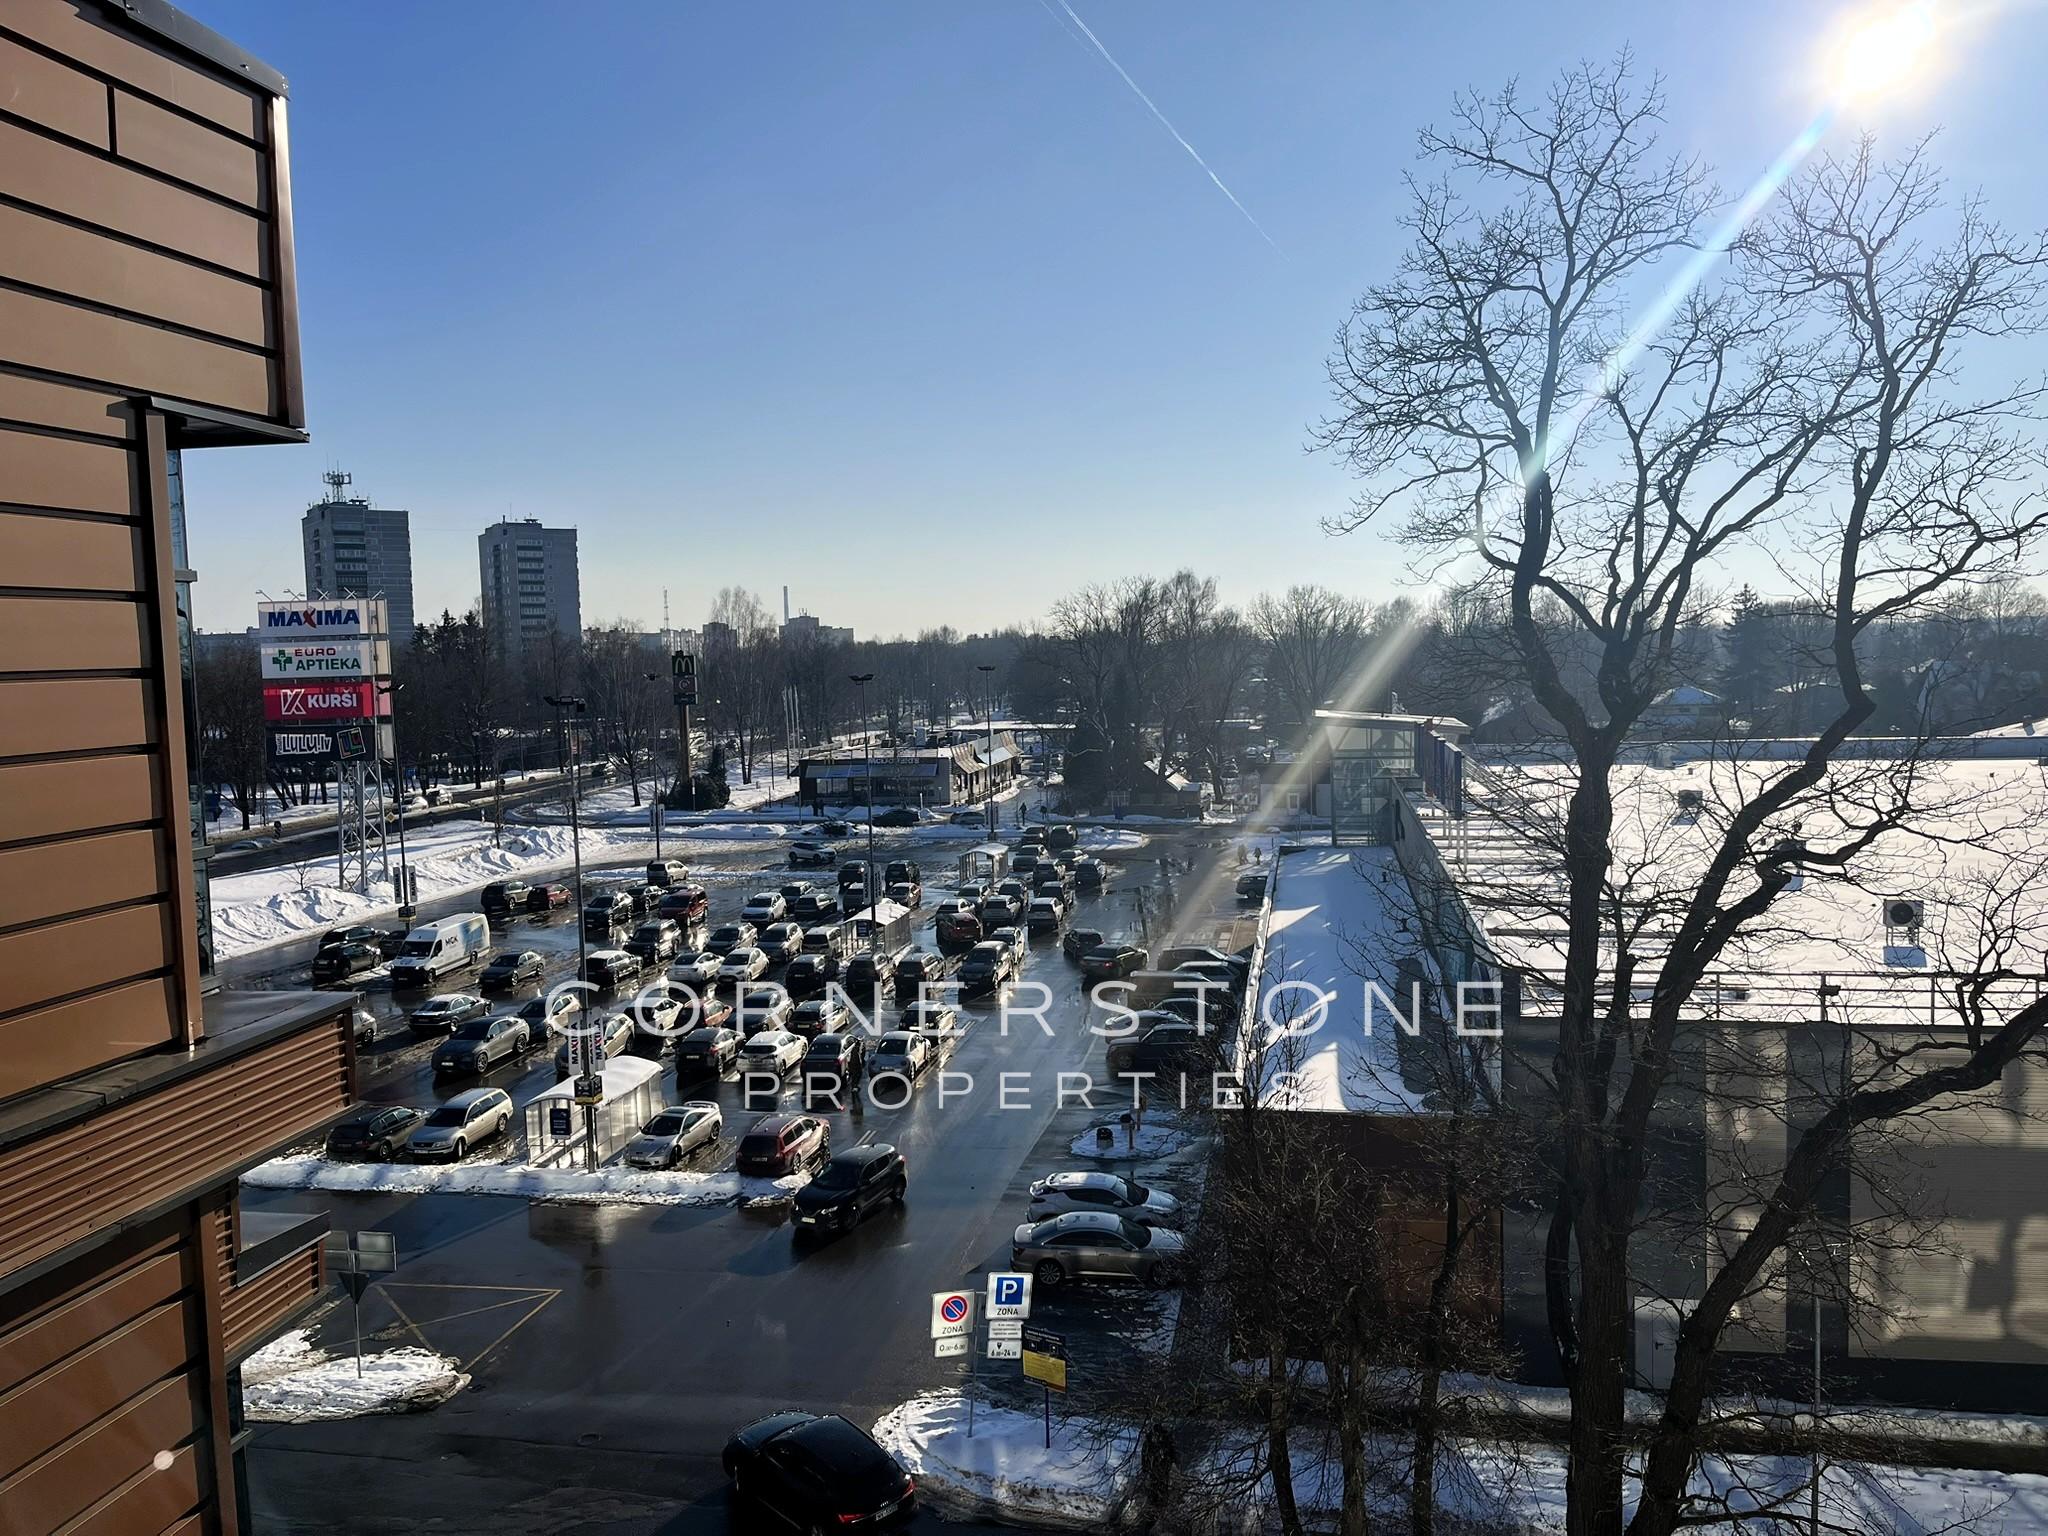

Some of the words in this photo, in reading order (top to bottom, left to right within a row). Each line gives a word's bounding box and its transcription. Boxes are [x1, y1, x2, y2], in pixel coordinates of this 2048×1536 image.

[268, 608, 360, 628] MAXIMA
[294, 647, 336, 657] EURO
[295, 658, 361, 671] APTIEKA
[308, 689, 357, 708] KURŠI
[1001, 1280, 1018, 1302] P
[997, 1308, 1019, 1316] ZONA
[942, 1325, 964, 1335] ZONA
